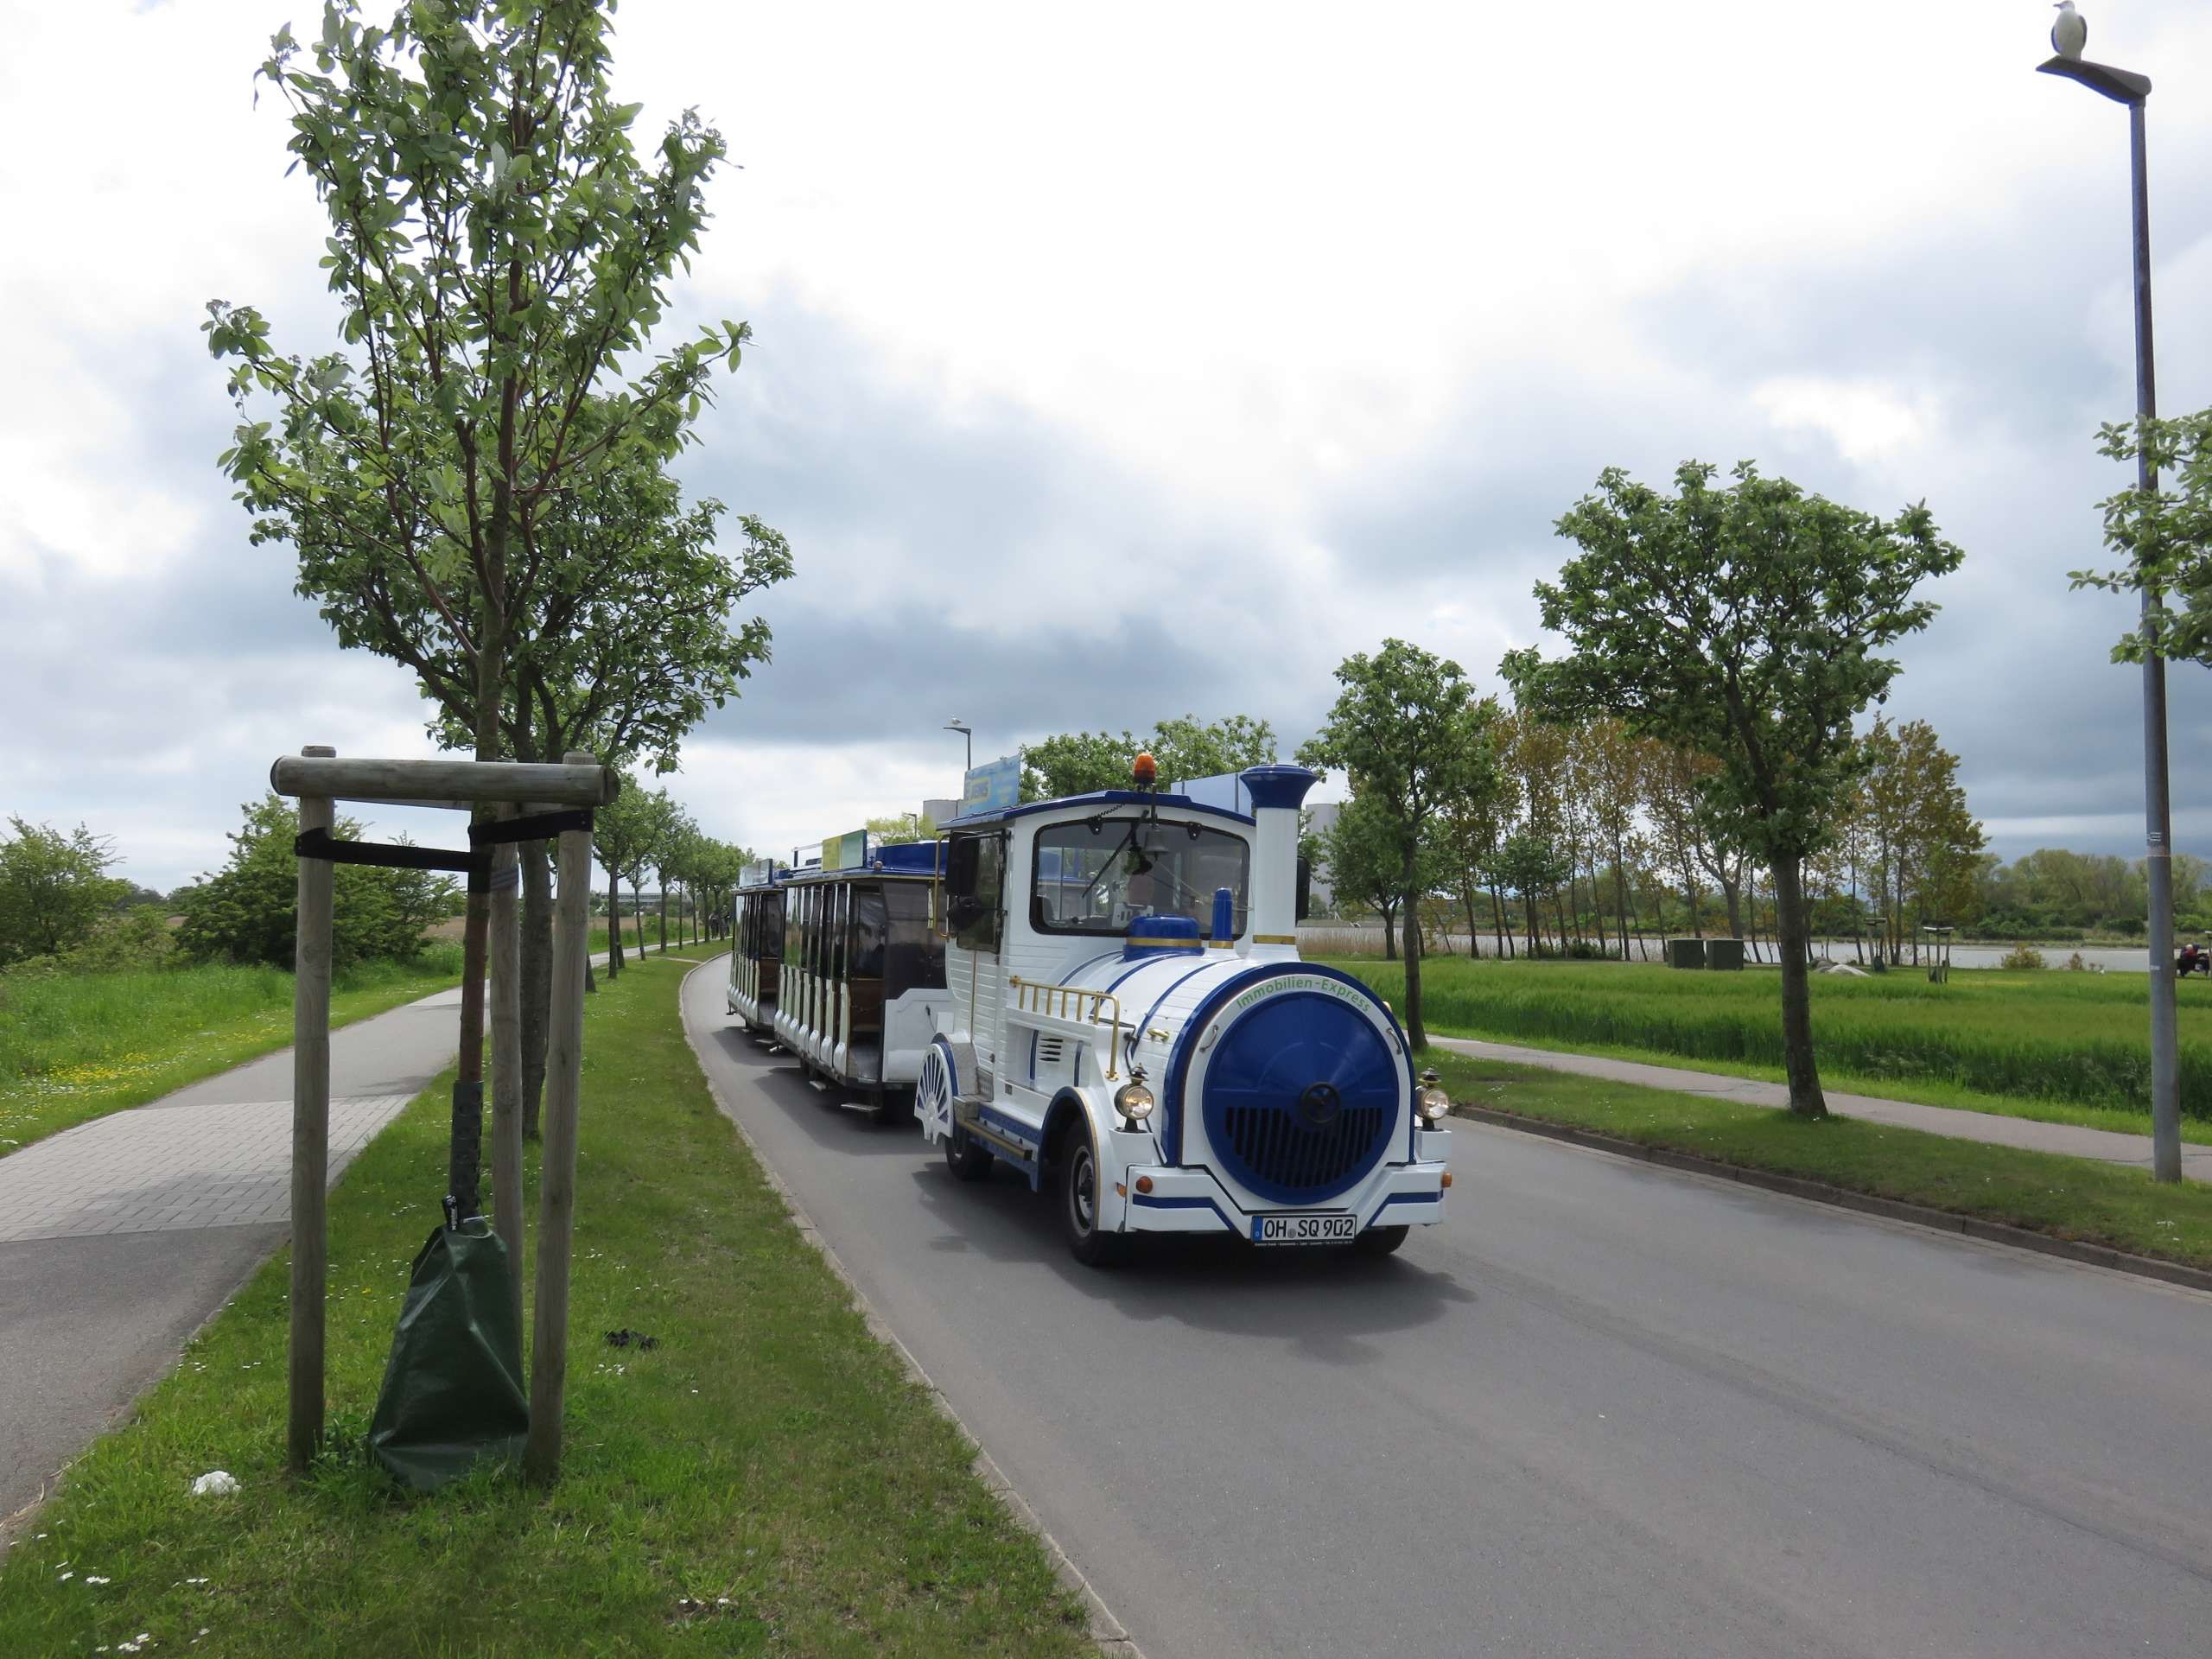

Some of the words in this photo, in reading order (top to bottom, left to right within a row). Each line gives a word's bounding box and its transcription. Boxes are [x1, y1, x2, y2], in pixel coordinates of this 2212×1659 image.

[1264, 1219, 1287, 1238] OH
[1297, 1219, 1319, 1237] SQ
[1323, 1218, 1354, 1236] 902
